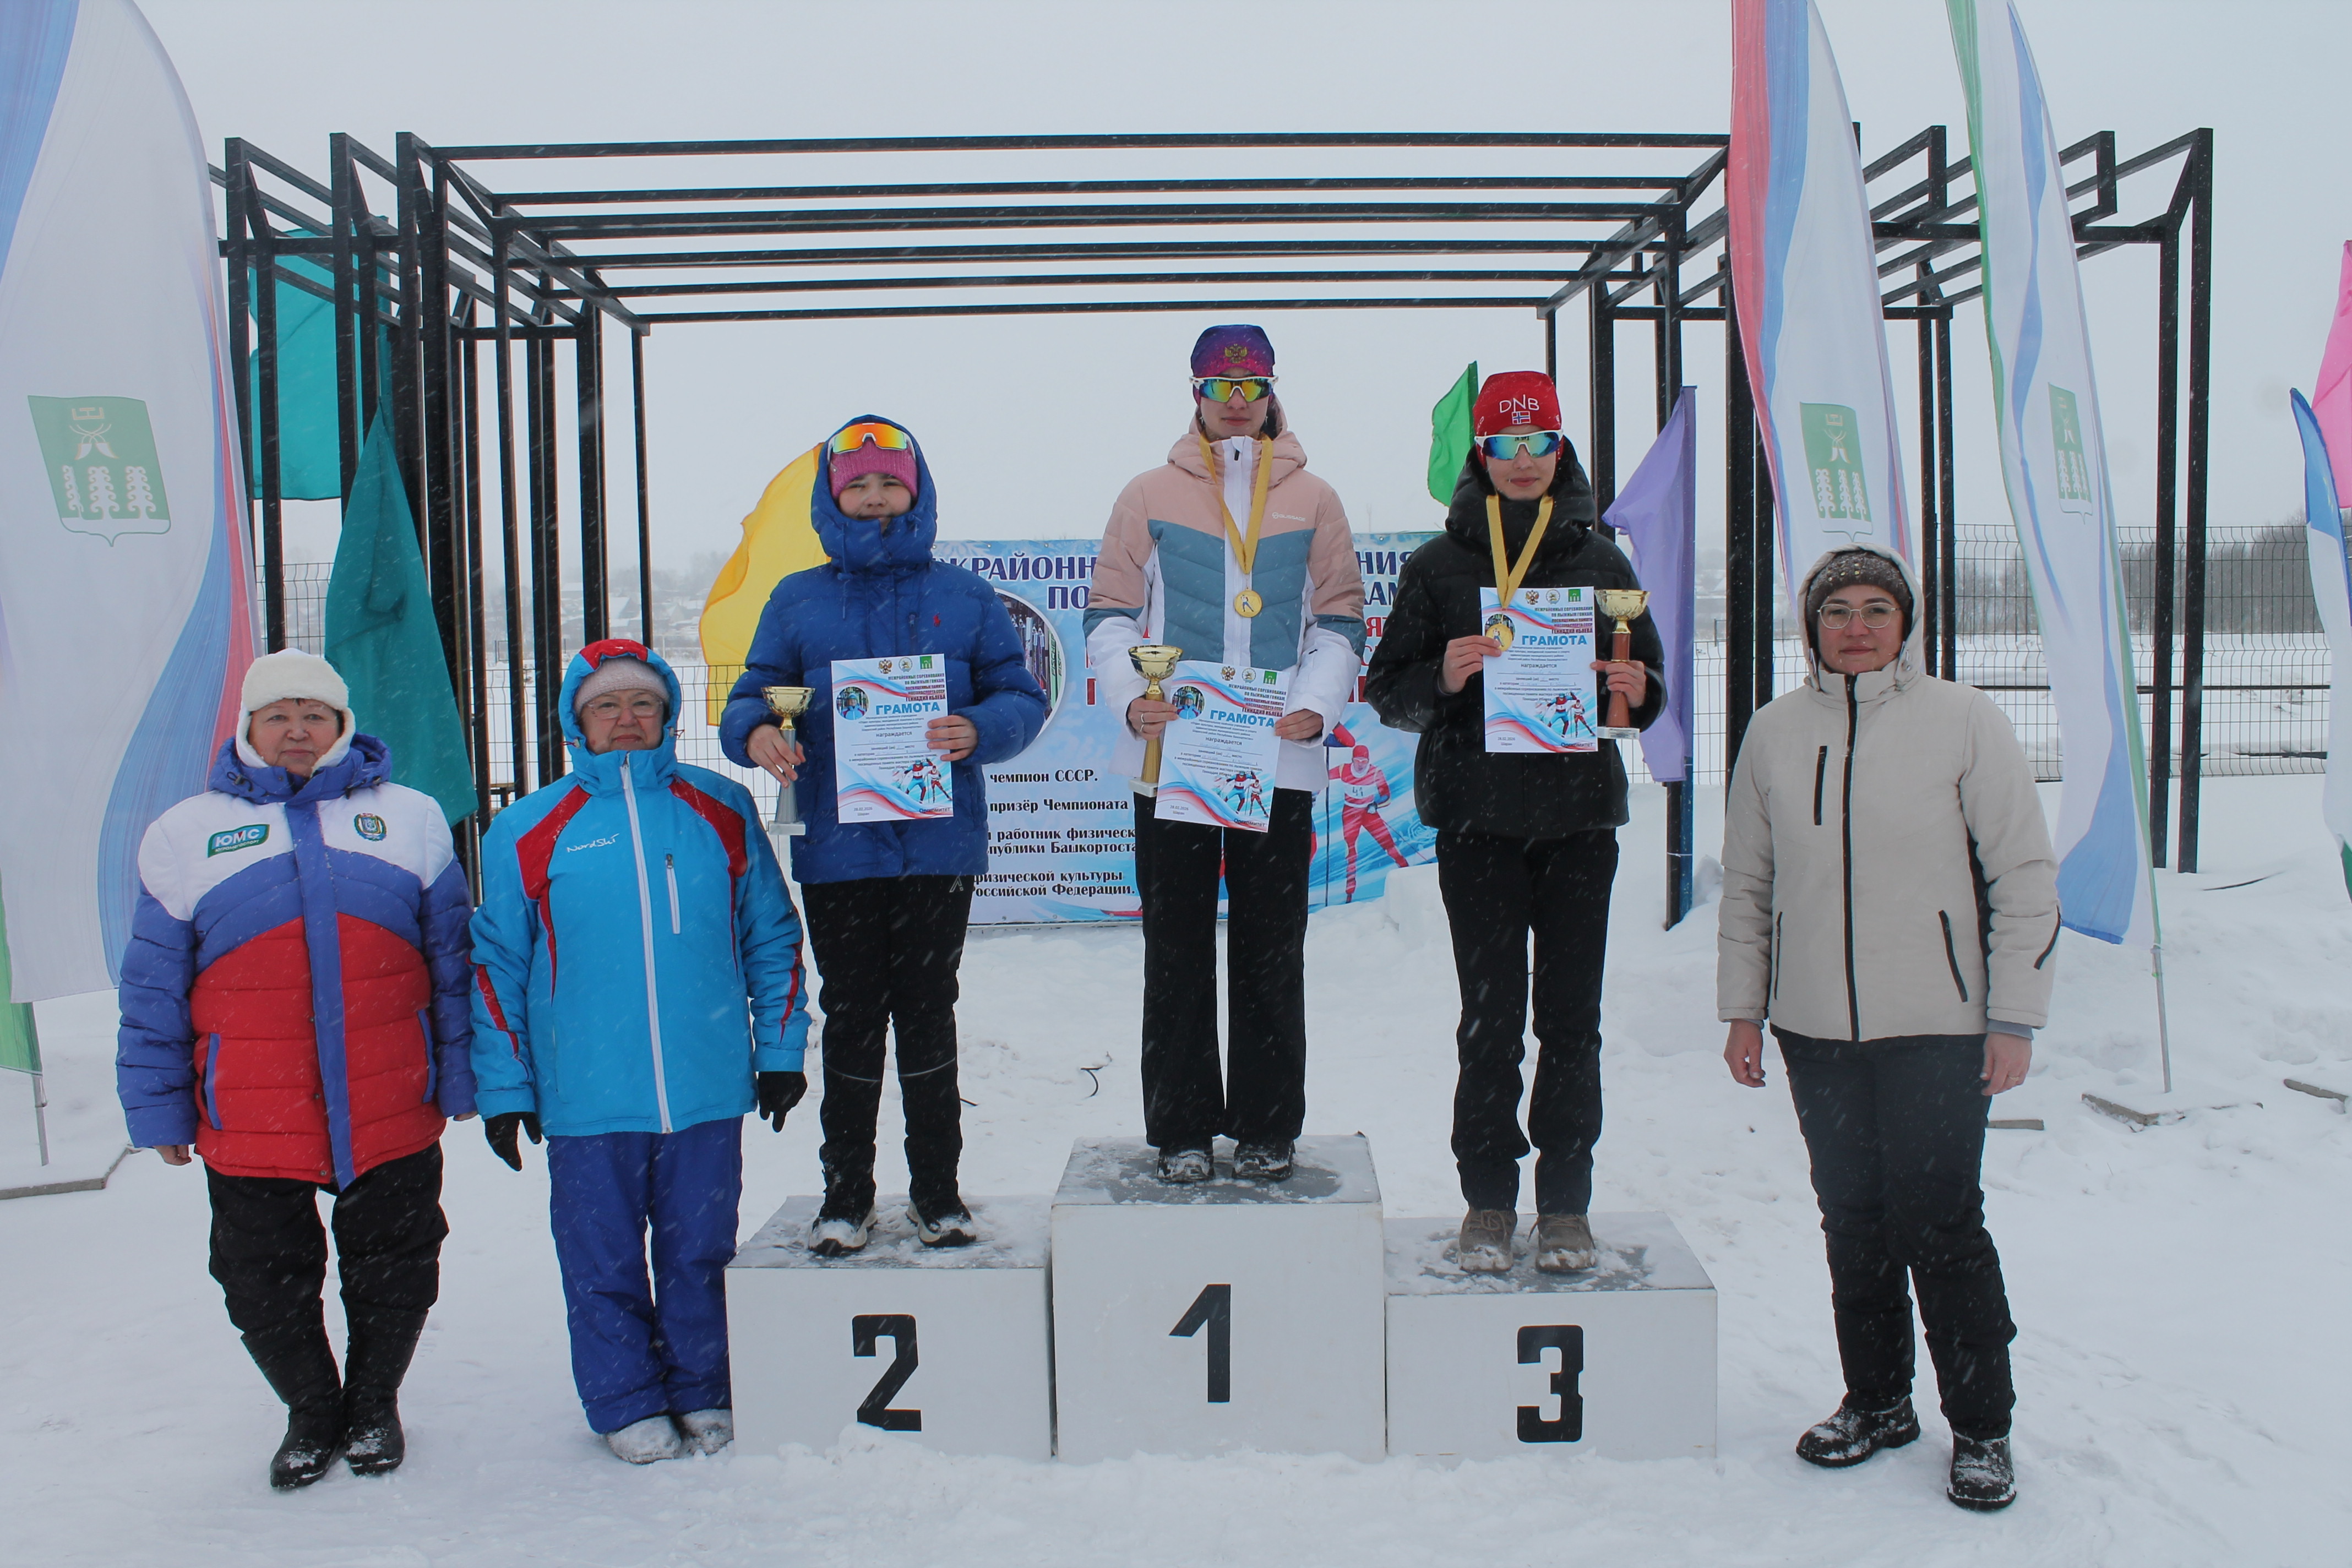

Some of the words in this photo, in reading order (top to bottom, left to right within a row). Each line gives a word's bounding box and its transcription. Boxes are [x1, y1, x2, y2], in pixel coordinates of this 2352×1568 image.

[1499, 394, 1539, 413] DNB
[1048, 586, 1090, 609] ПО
[1522, 635, 1587, 645] ГРАМОТА
[875, 701, 940, 715] ГРАМОТА
[1210, 710, 1275, 727] ГРАМОТА
[1205, 737, 1242, 745] награждается
[990, 772, 1049, 783] чемпион
[1055, 770, 1098, 782] СССР.
[1352, 786, 1363, 797] 41
[990, 799, 1038, 813] призёр
[1044, 799, 1128, 810] Чемпионата
[215, 829, 260, 847] ЮМС
[997, 829, 1061, 842] работник
[987, 842, 1045, 857] публики
[1060, 872, 1122, 884] культуры
[974, 885, 1046, 897] оссийской
[1052, 884, 1135, 897] Федерации.
[1169, 1284, 1231, 1402] 1
[852, 1315, 921, 1431] 2
[1517, 1325, 1583, 1442] 3
